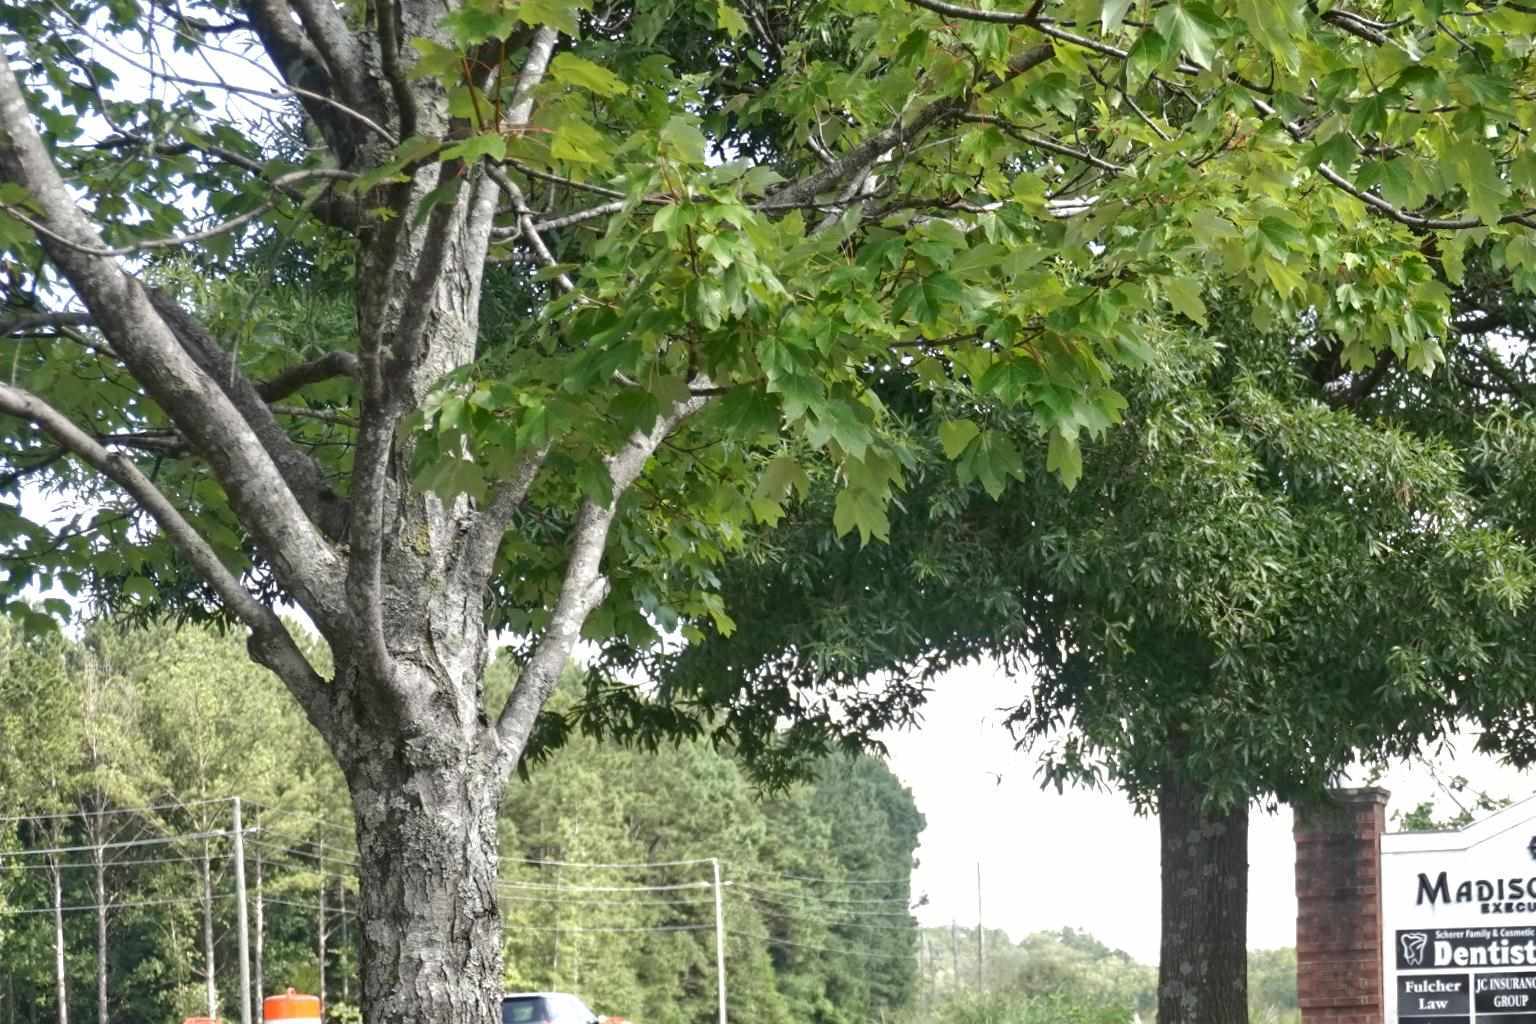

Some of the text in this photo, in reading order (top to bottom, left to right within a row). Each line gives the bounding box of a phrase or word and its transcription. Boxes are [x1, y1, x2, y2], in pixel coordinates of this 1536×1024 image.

[1465, 928, 1491, 940] Family
[1405, 980, 1462, 994] Fulcher
[1475, 978, 1488, 994] JC
[1418, 997, 1449, 1011] Law
[1493, 994, 1529, 1008] GROUP
